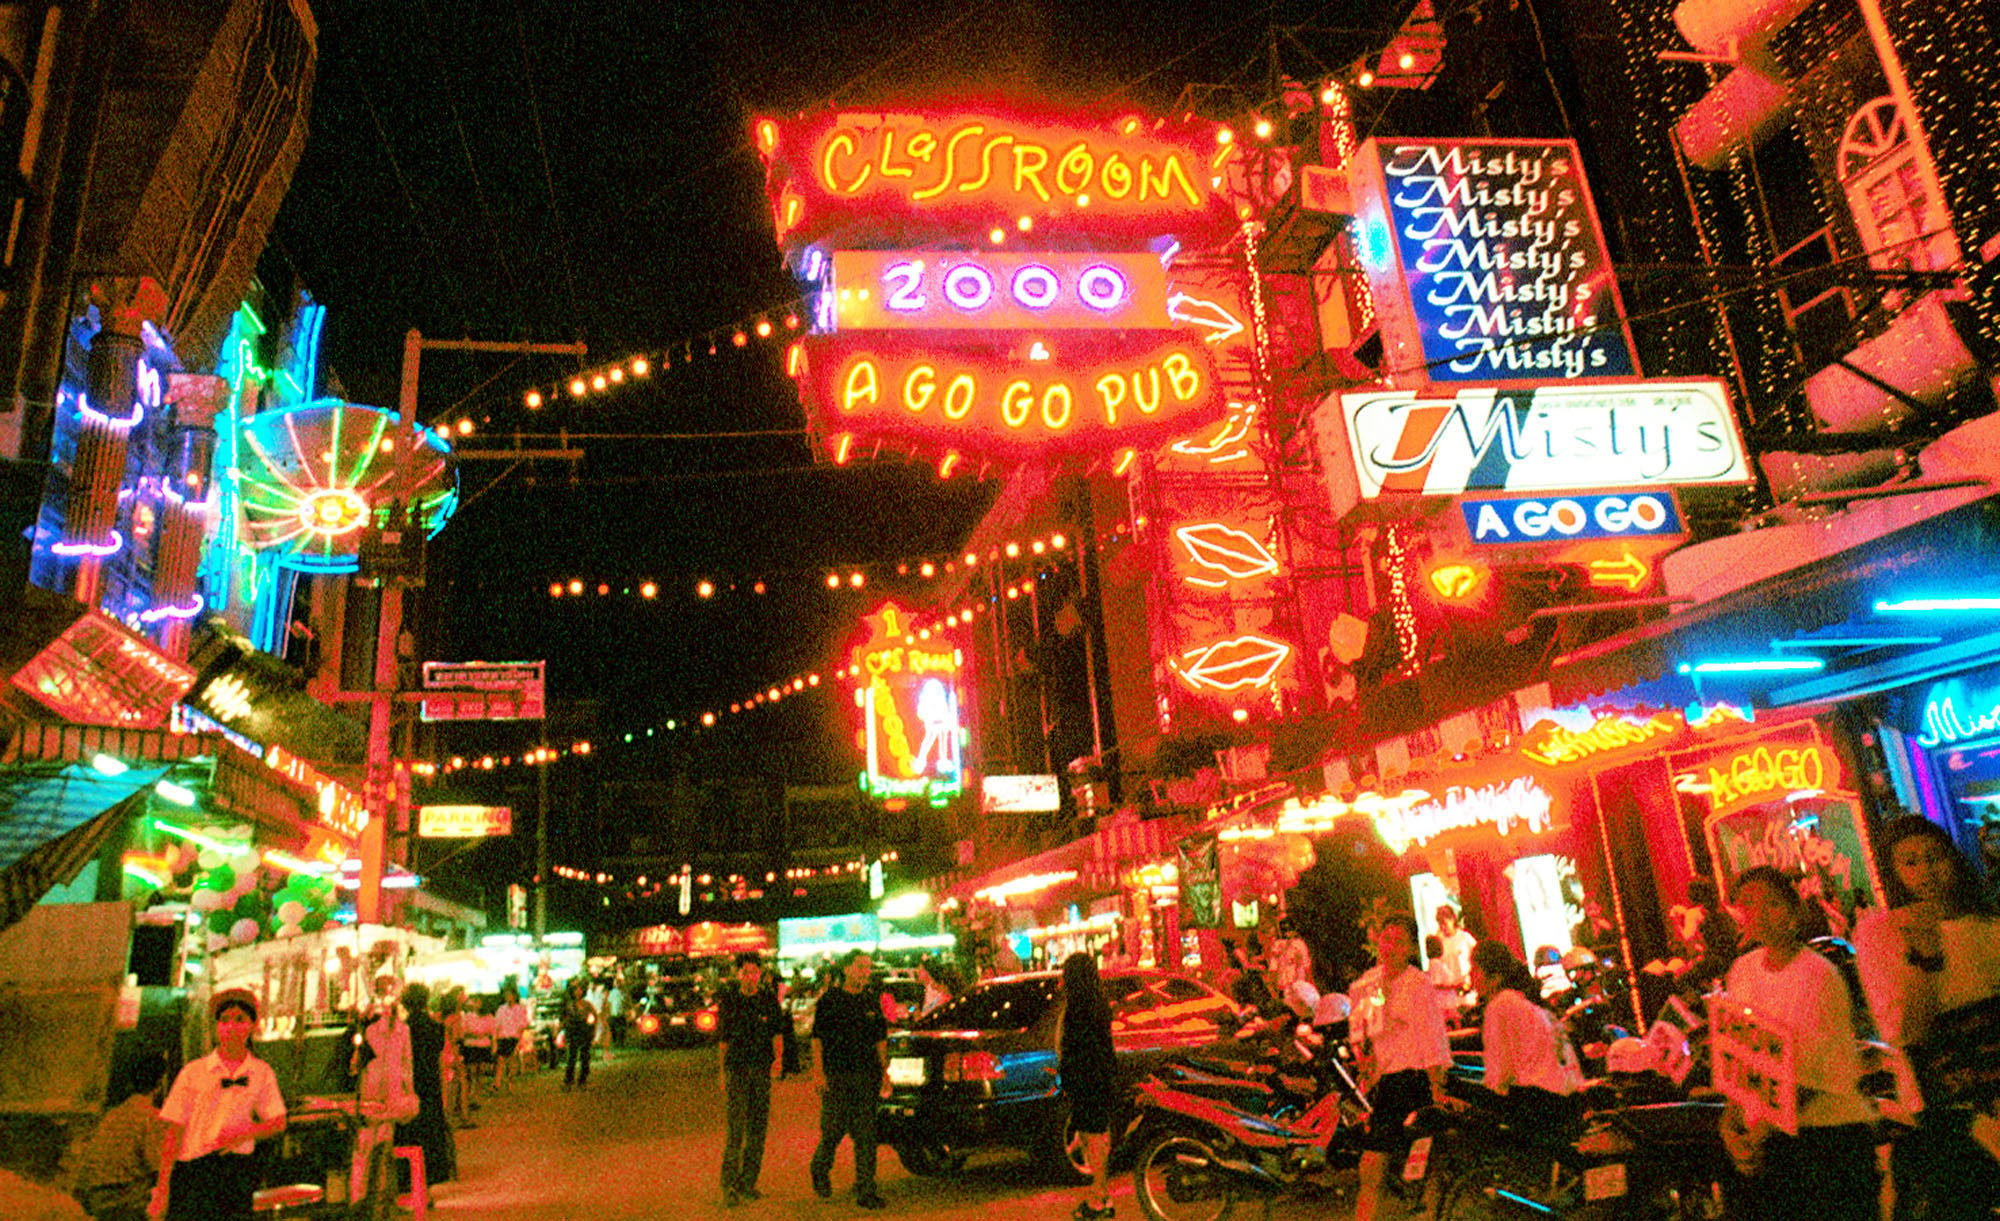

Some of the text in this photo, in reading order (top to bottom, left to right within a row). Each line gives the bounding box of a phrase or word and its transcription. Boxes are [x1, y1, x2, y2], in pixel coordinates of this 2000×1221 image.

[1385, 146, 1569, 185] Misty's
[1394, 175, 1576, 216] Misty's
[1404, 206, 1582, 248] Misty's
[1415, 238, 1586, 285] Misty's
[884, 262, 1127, 312] 2000
[1427, 270, 1593, 313] Misty's
[1438, 304, 1598, 346] Misty's
[1449, 336, 1608, 379] Misty's
[844, 352, 1201, 429] A GO GO PUB
[1370, 397, 1722, 480] Misty's
[1475, 496, 1667, 540] A GO GO
